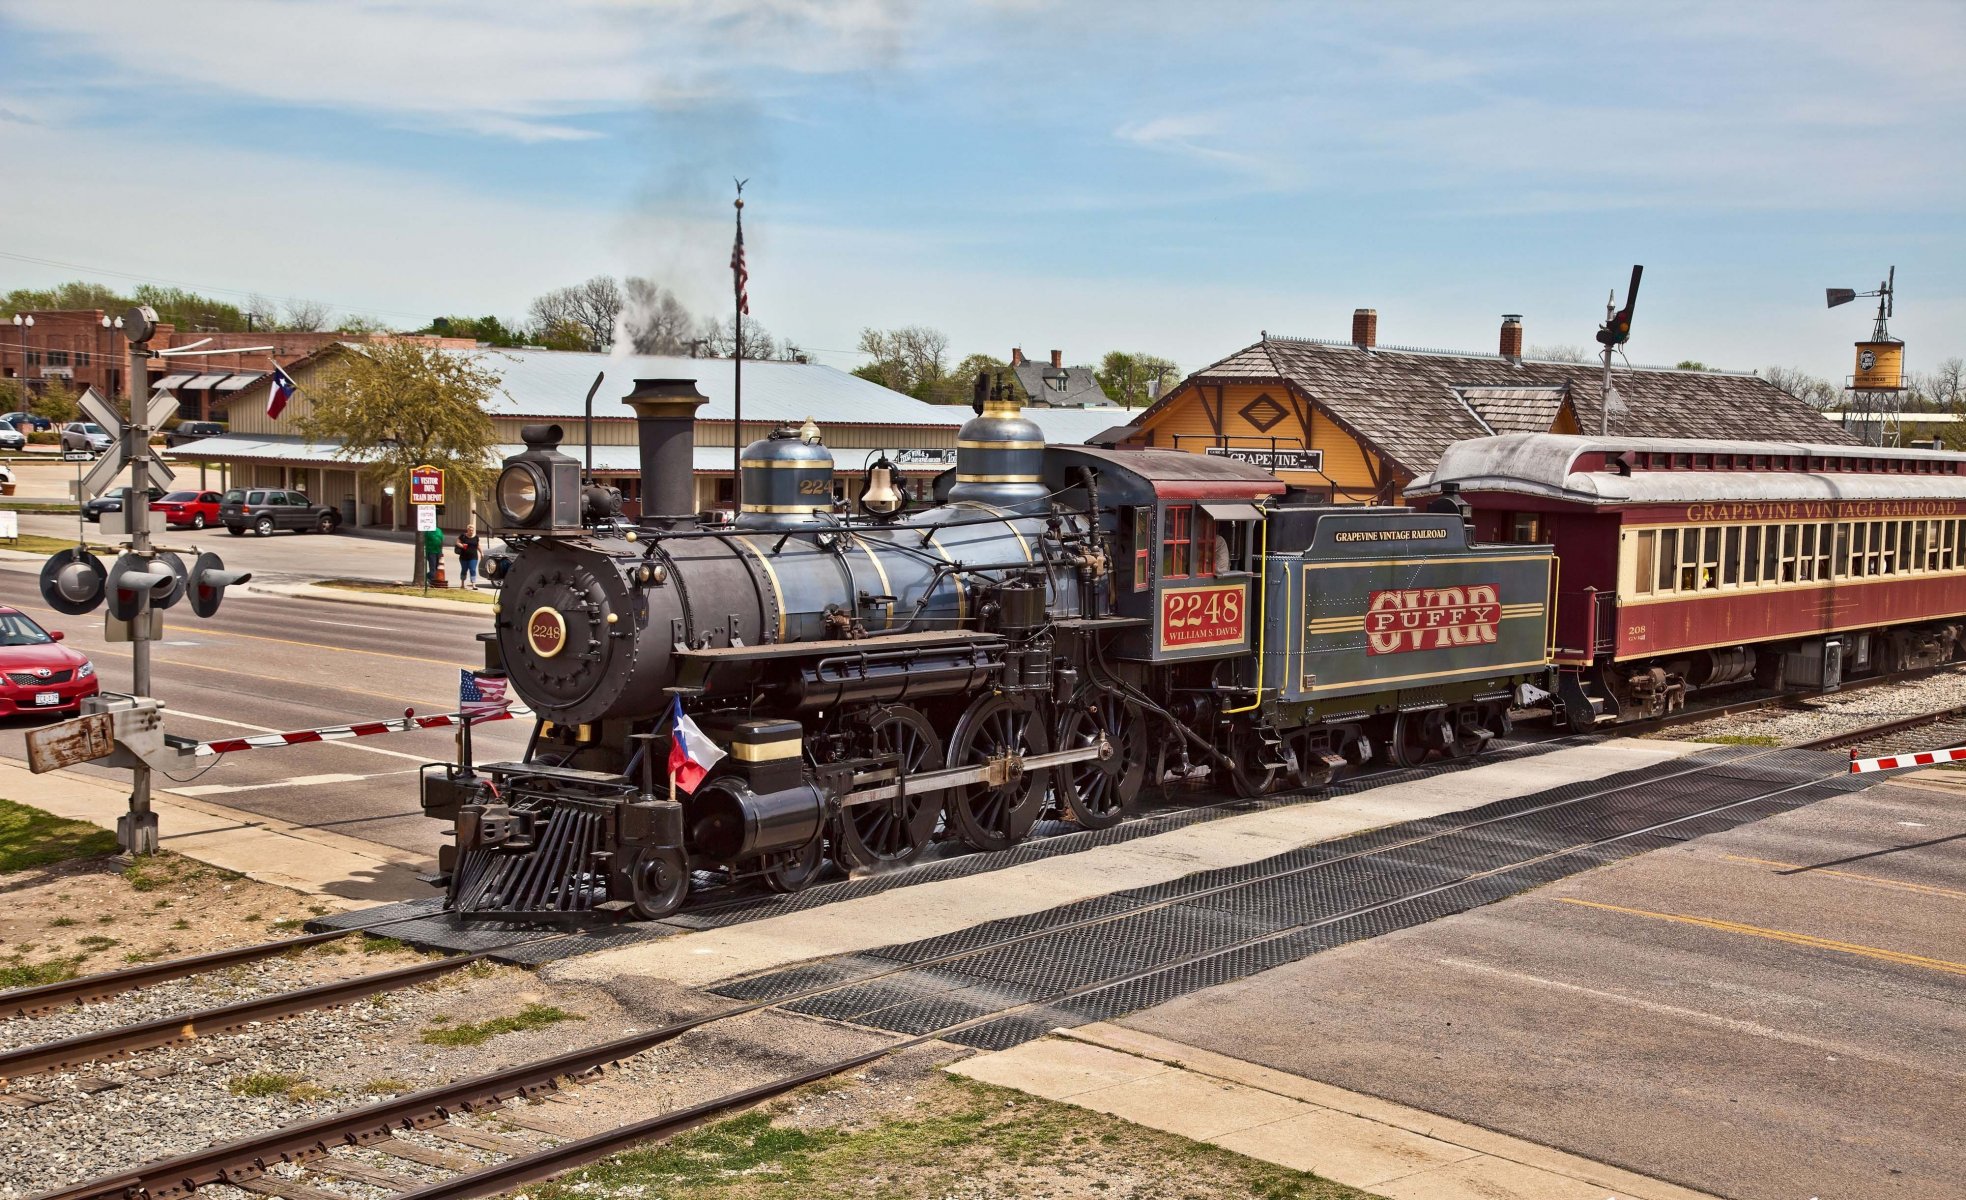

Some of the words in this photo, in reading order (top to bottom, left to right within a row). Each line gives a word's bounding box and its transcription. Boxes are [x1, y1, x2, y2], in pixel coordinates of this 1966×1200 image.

[420, 476, 439, 485] VISITOR
[413, 493, 427, 501] TRAIN
[427, 493, 442, 501] DEPOT
[1687, 502, 1798, 522] GRAPEVINE
[1805, 501, 1877, 519] VINTAGE
[1882, 500, 1957, 517] RAILROAD
[1335, 531, 1378, 542] GRAPEVINE
[1379, 530, 1410, 540] VINTAGE
[1411, 529, 1447, 540] RAILROAD
[1169, 592, 1238, 628] 2248
[1374, 606, 1493, 631] PUFFY
[532, 624, 560, 639] 2248
[1169, 629, 1207, 641] WILLIAM
[1208, 628, 1214, 637] S.
[1216, 626, 1238, 636] DAVIS
[1628, 625, 1646, 635] 208
